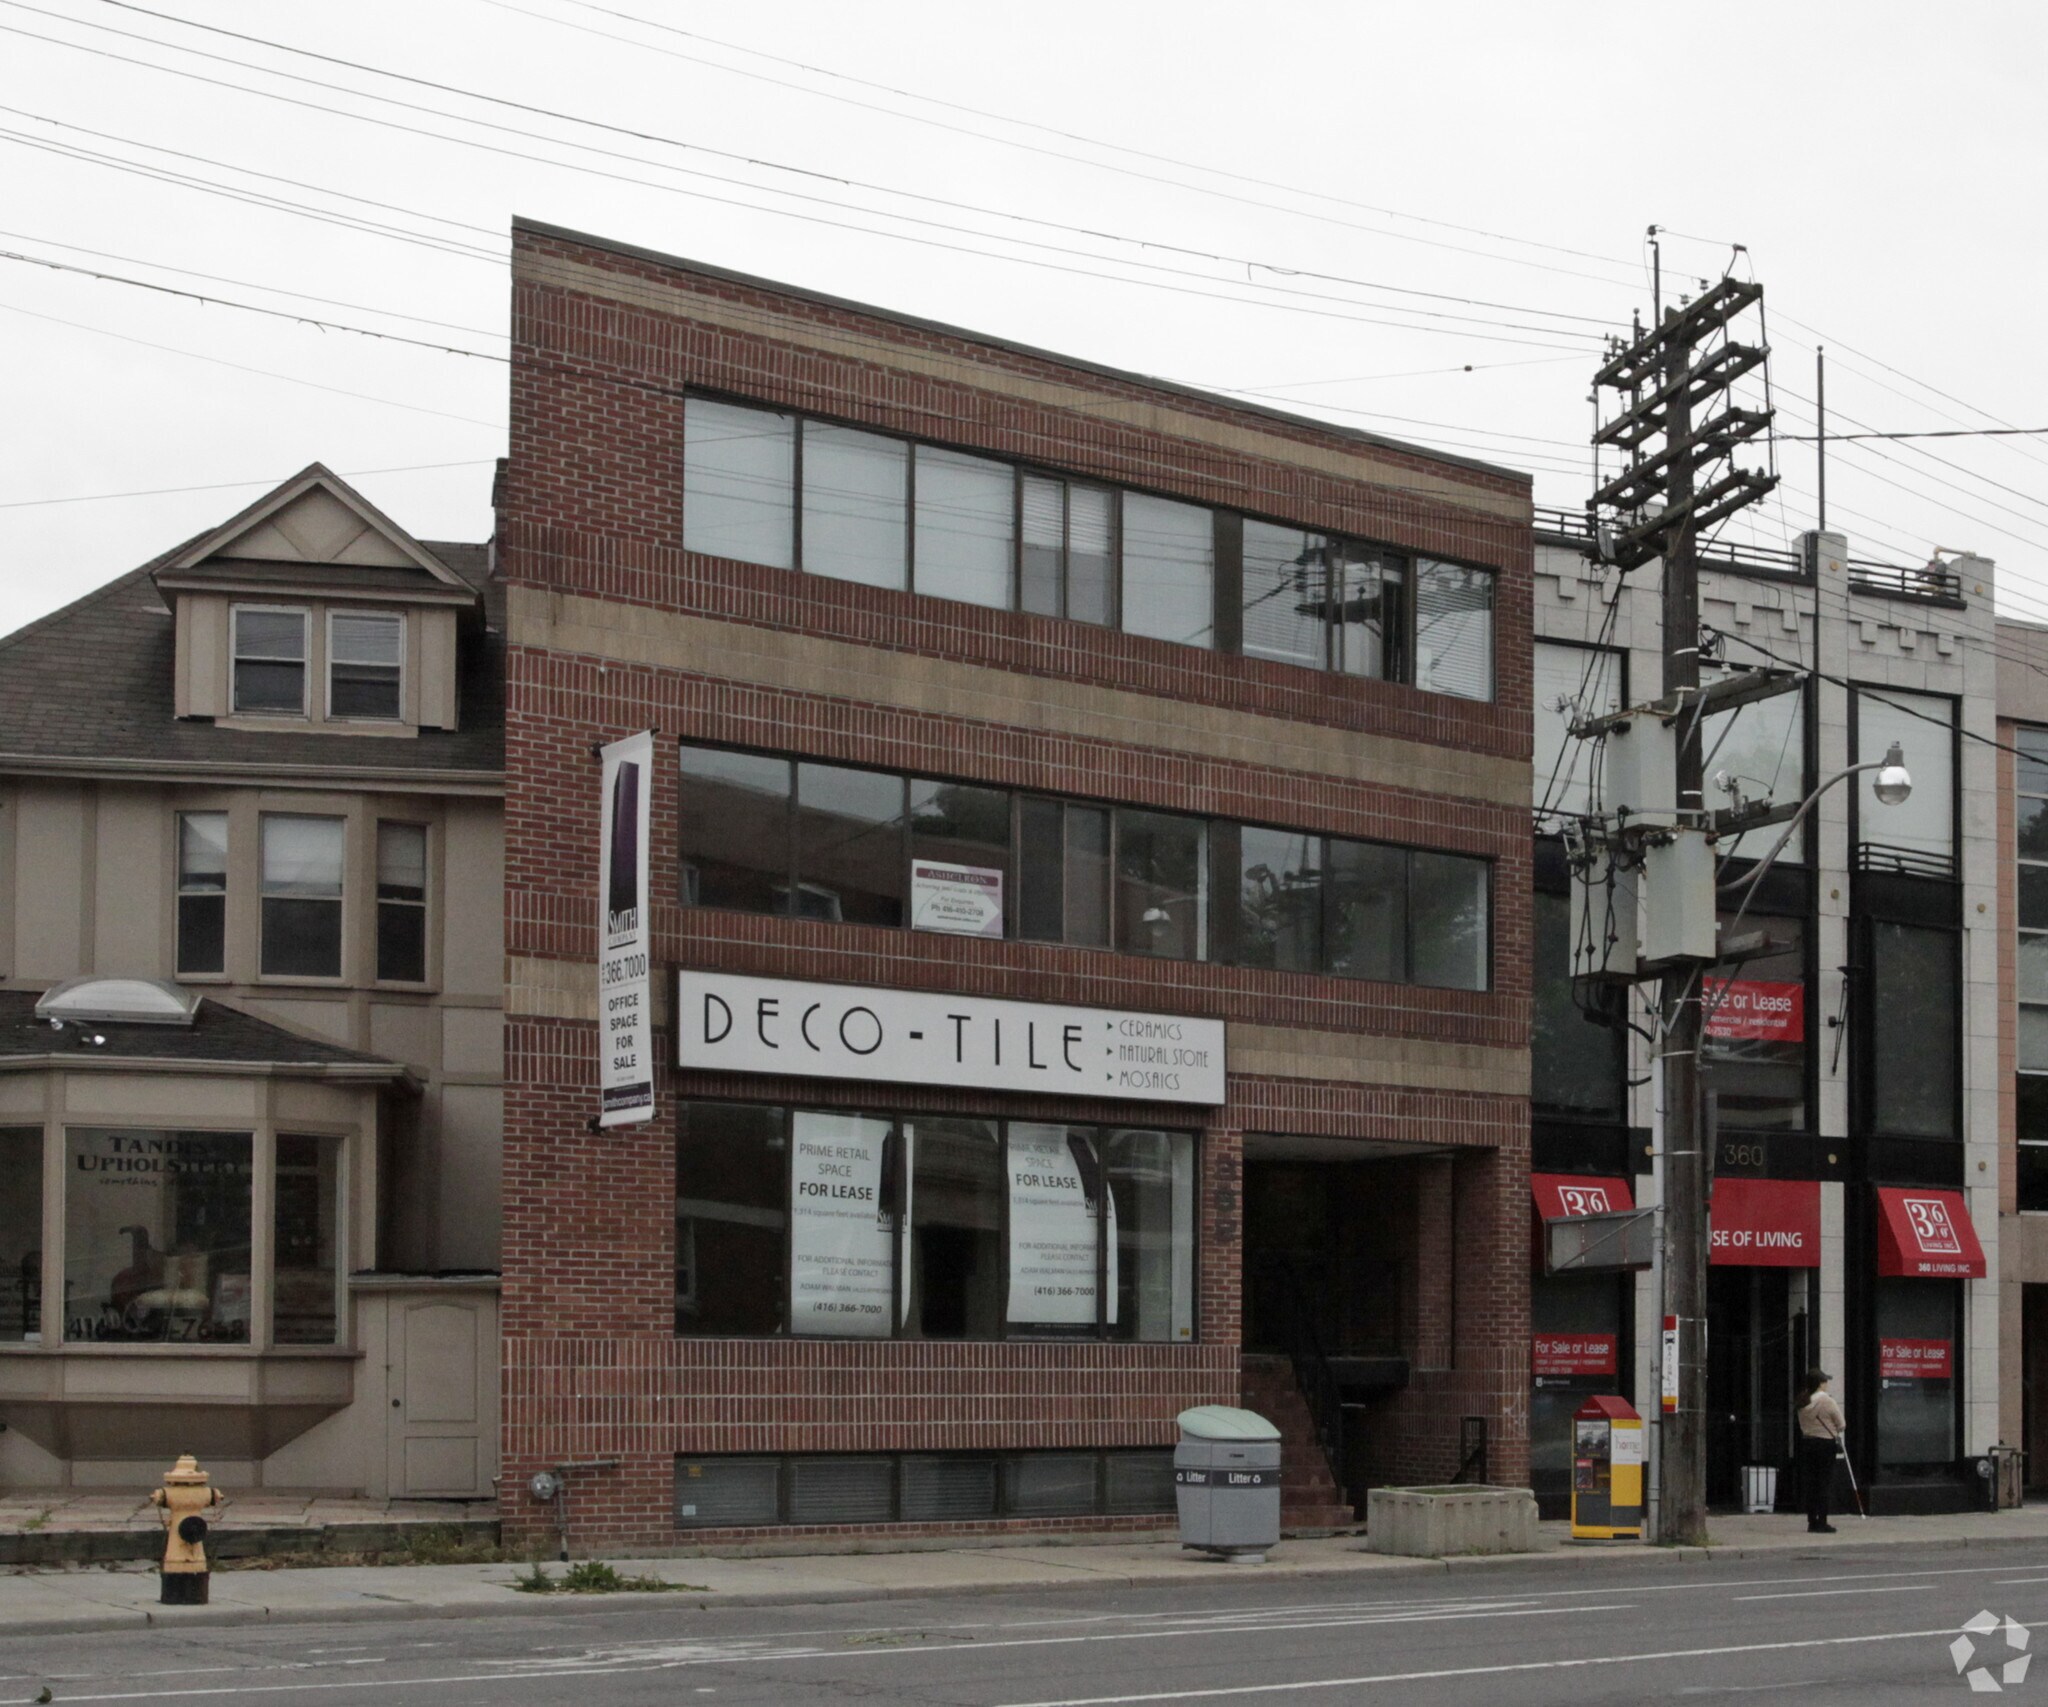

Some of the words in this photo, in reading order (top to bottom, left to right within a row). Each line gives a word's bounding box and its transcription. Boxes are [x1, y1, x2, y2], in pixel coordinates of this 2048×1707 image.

[608, 907, 638, 936] SMITH
[606, 953, 646, 984] 366.7000
[608, 993, 639, 1012] OFFICE
[1733, 994, 1748, 1009] or
[1752, 992, 1792, 1012] Lease
[610, 1013, 638, 1031] SPACE
[1119, 1019, 1182, 1041] CERAMICS
[616, 1035, 634, 1050] FOR
[613, 1054, 637, 1071] SALE
[1119, 1044, 1168, 1065] NATURAL
[1173, 1048, 1209, 1068] STONE
[1119, 1070, 1181, 1090] MOSAICS
[799, 1143, 834, 1158] PRIME
[836, 1147, 871, 1161] RETAIL
[1725, 1144, 1764, 1167] 360
[818, 1163, 852, 1178] SPACE
[1016, 1173, 1040, 1187] FOR
[1043, 1175, 1078, 1189] LEASE
[800, 1182, 828, 1197] FOR
[832, 1184, 873, 1201] LEASE
[1710, 1230, 1730, 1247] SE
[1732, 1230, 1752, 1247] OF
[1755, 1231, 1803, 1248] LIVING
[1932, 1263, 1956, 1273] LIVING
[1034, 1286, 1055, 1296] (416)
[1057, 1286, 1095, 1296] 366-7000
[813, 1302, 837, 1313] (416)
[838, 1303, 883, 1314] 366-7000
[1535, 1341, 1549, 1354] For
[1551, 1341, 1571, 1354] Sale
[1572, 1343, 1582, 1354] or
[1584, 1342, 1609, 1354] Lease
[1882, 1345, 1894, 1358] For
[1896, 1346, 1912, 1358] Sale
[1913, 1348, 1921, 1358] or
[1923, 1346, 1945, 1359] Lease
[1186, 1471, 1206, 1483] Litter
[1228, 1472, 1252, 1484] Litter
